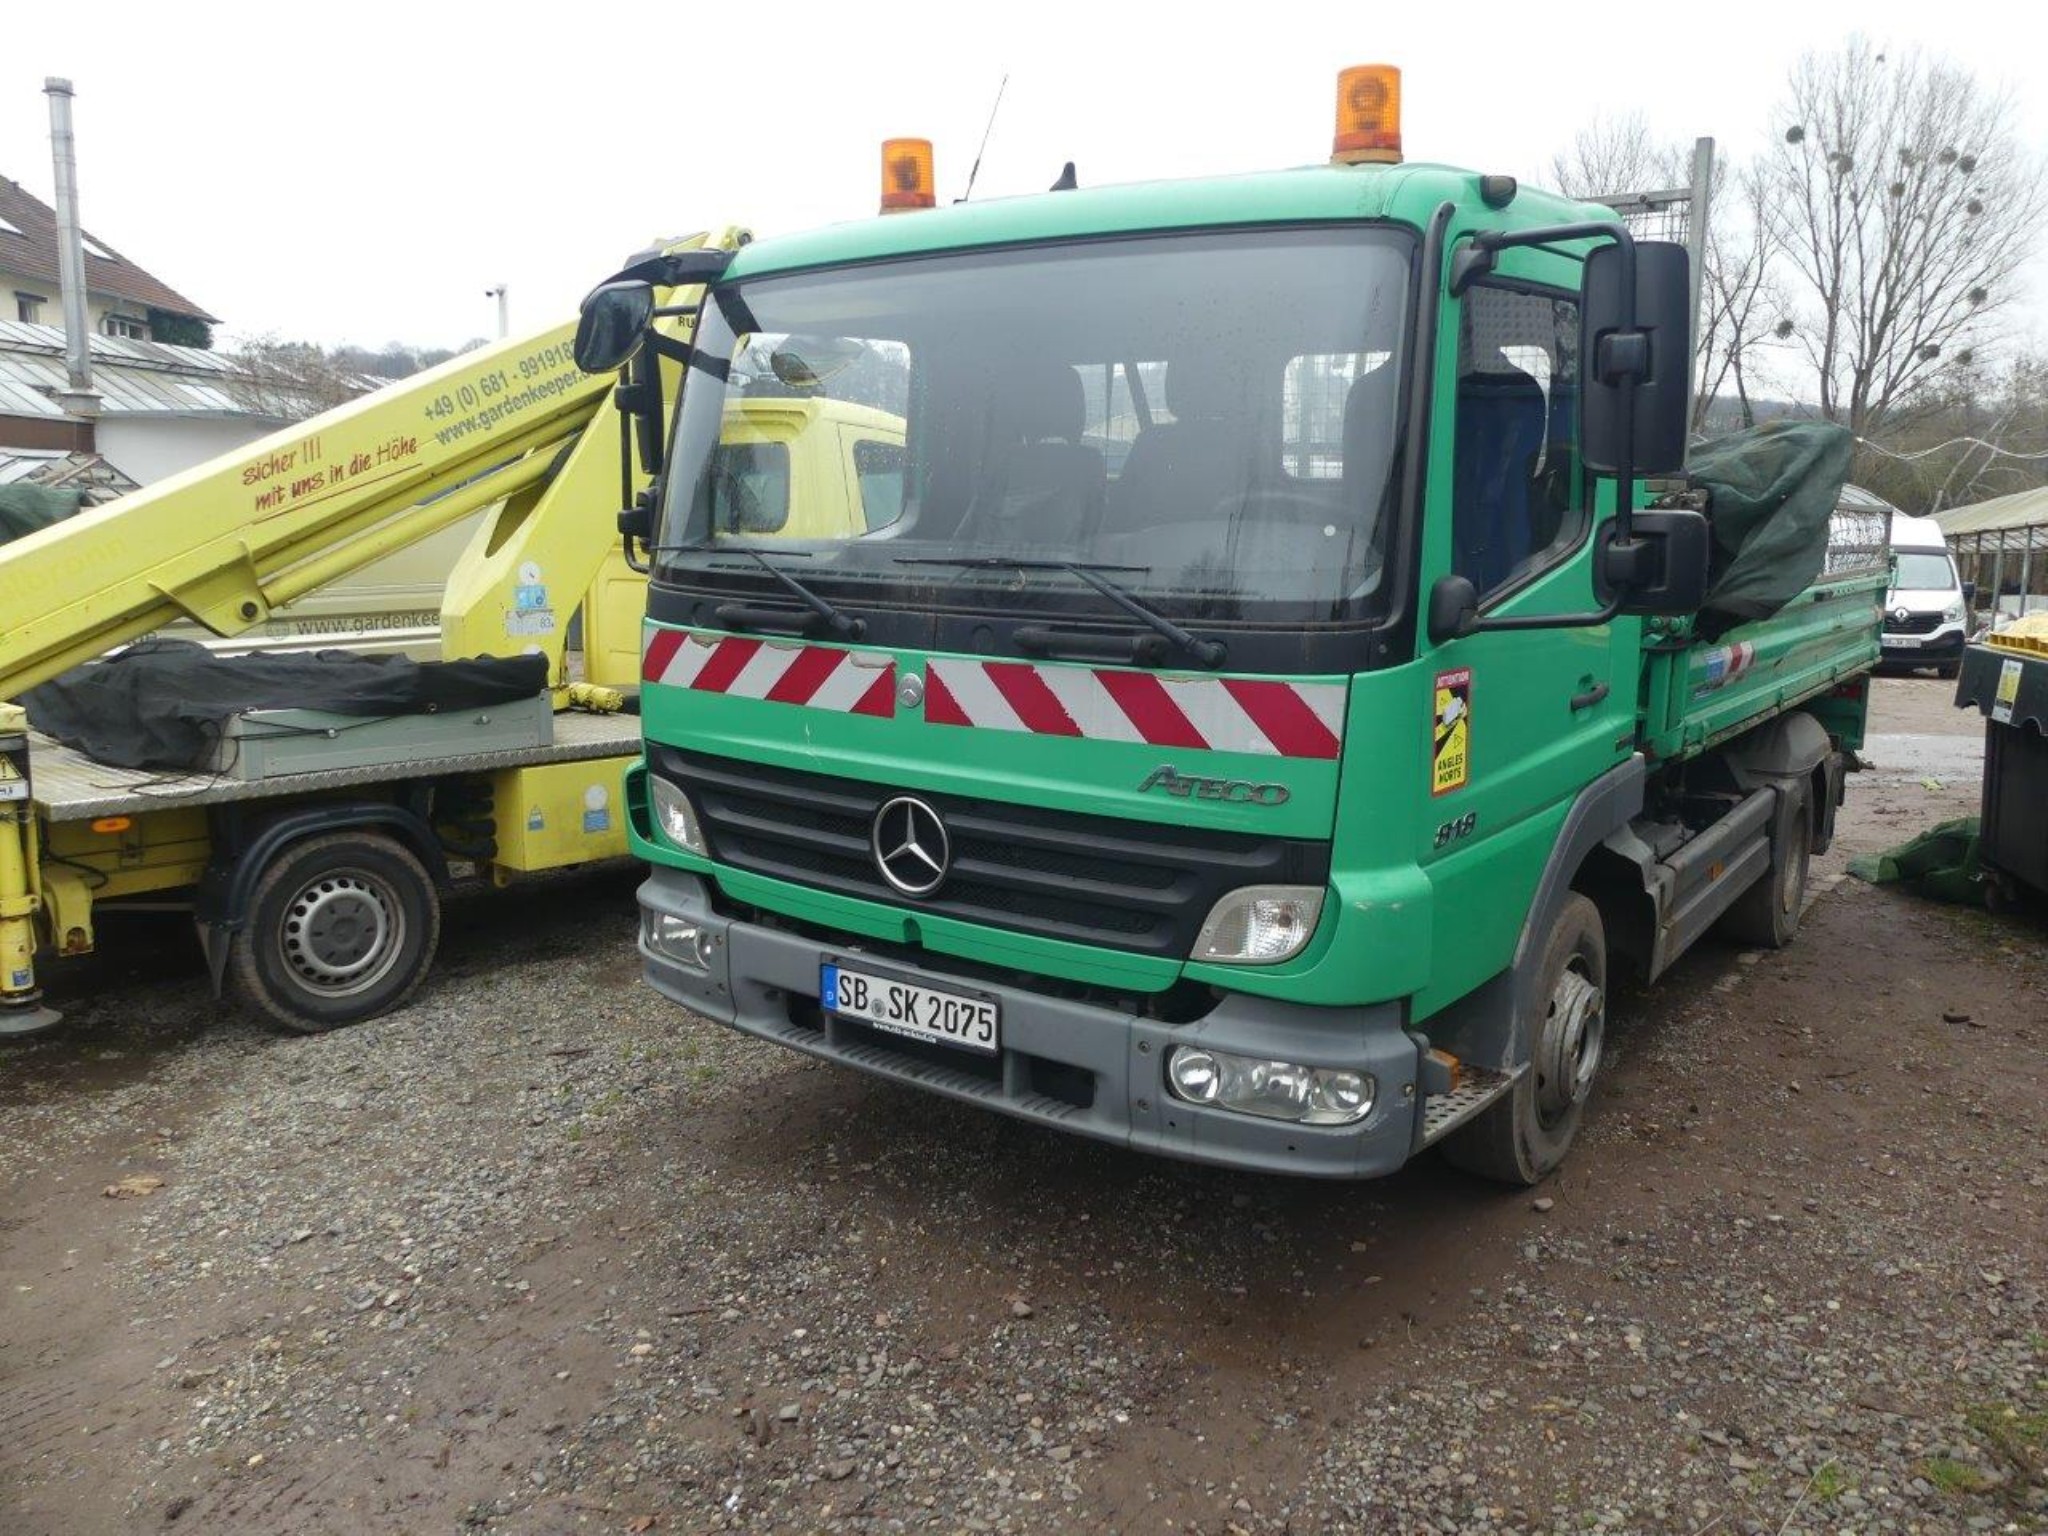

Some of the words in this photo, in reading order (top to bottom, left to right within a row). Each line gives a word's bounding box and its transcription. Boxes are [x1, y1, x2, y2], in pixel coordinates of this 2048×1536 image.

[424, 394, 454, 420] +49
[456, 383, 481, 412] (0)
[480, 370, 510, 397] 681
[243, 451, 297, 485] sicher
[255, 485, 285, 512] mit
[292, 472, 325, 498] uns
[330, 464, 344, 483] in
[350, 452, 371, 476] die
[377, 436, 418, 465] Höhe
[1438, 753, 1463, 771] ANGLES
[839, 975, 868, 1011] SB
[888, 986, 919, 1025] SK
[928, 996, 993, 1041] 2075
